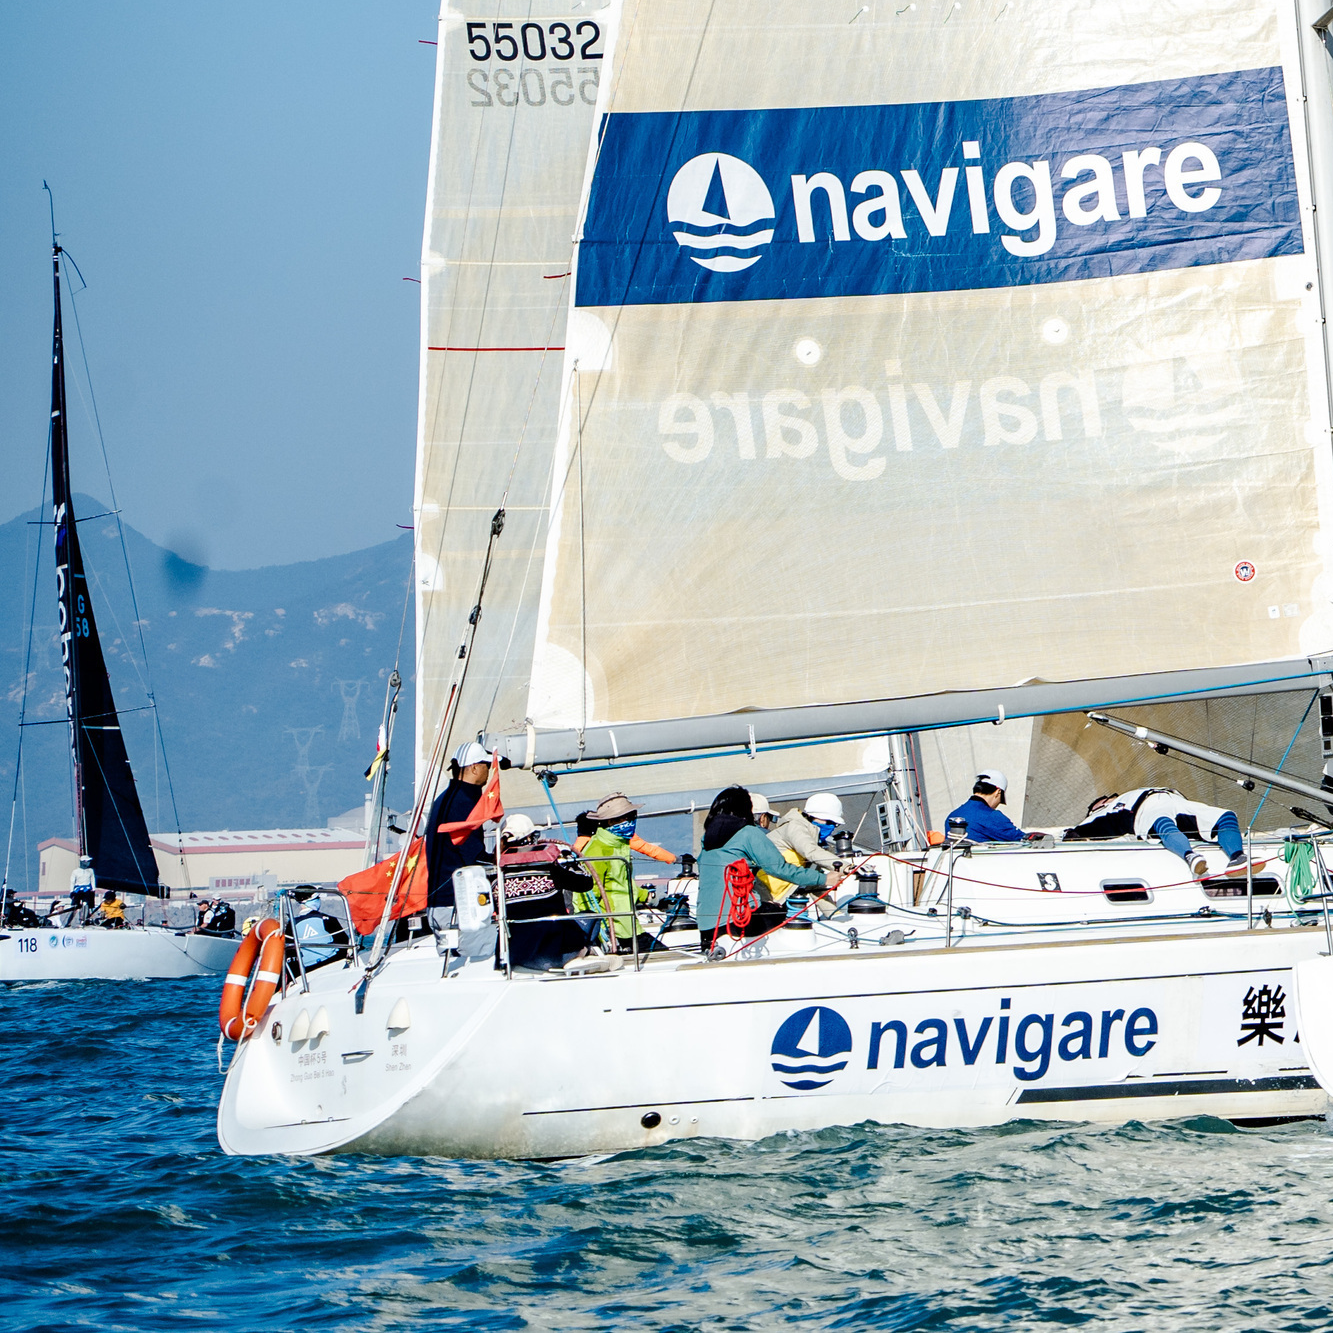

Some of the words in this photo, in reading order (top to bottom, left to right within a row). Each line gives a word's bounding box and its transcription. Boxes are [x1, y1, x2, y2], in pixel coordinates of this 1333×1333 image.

[466, 20, 604, 62] 55032
[790, 139, 1223, 257] navigare
[18, 937, 38, 953] 118
[866, 998, 1159, 1082] navigare
[1236, 983, 1303, 1048] 樂
[298, 1051, 328, 1068] 中国杯5号
